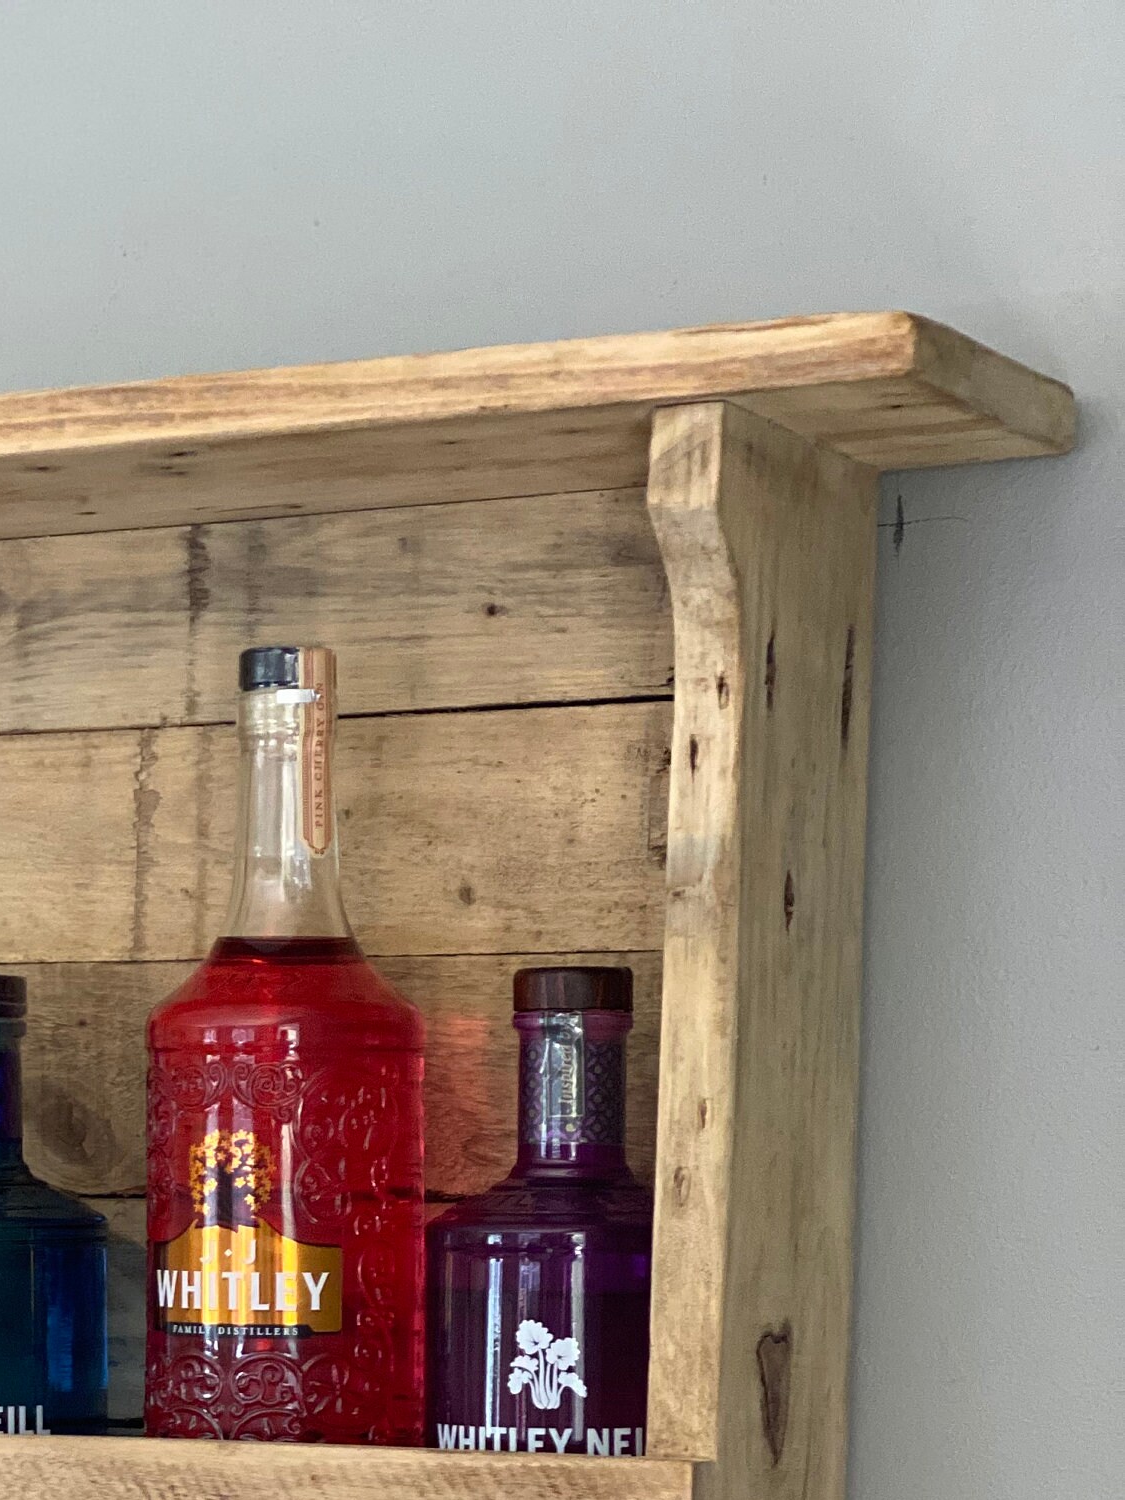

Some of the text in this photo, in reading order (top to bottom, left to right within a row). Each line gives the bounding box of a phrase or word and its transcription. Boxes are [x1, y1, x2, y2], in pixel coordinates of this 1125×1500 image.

[315, 717, 325, 781] CHERRY
[315, 789, 324, 828] PINK
[156, 1269, 330, 1311] WHITLEY
[172, 1324, 299, 1336] FAMILY DISTILLERS
